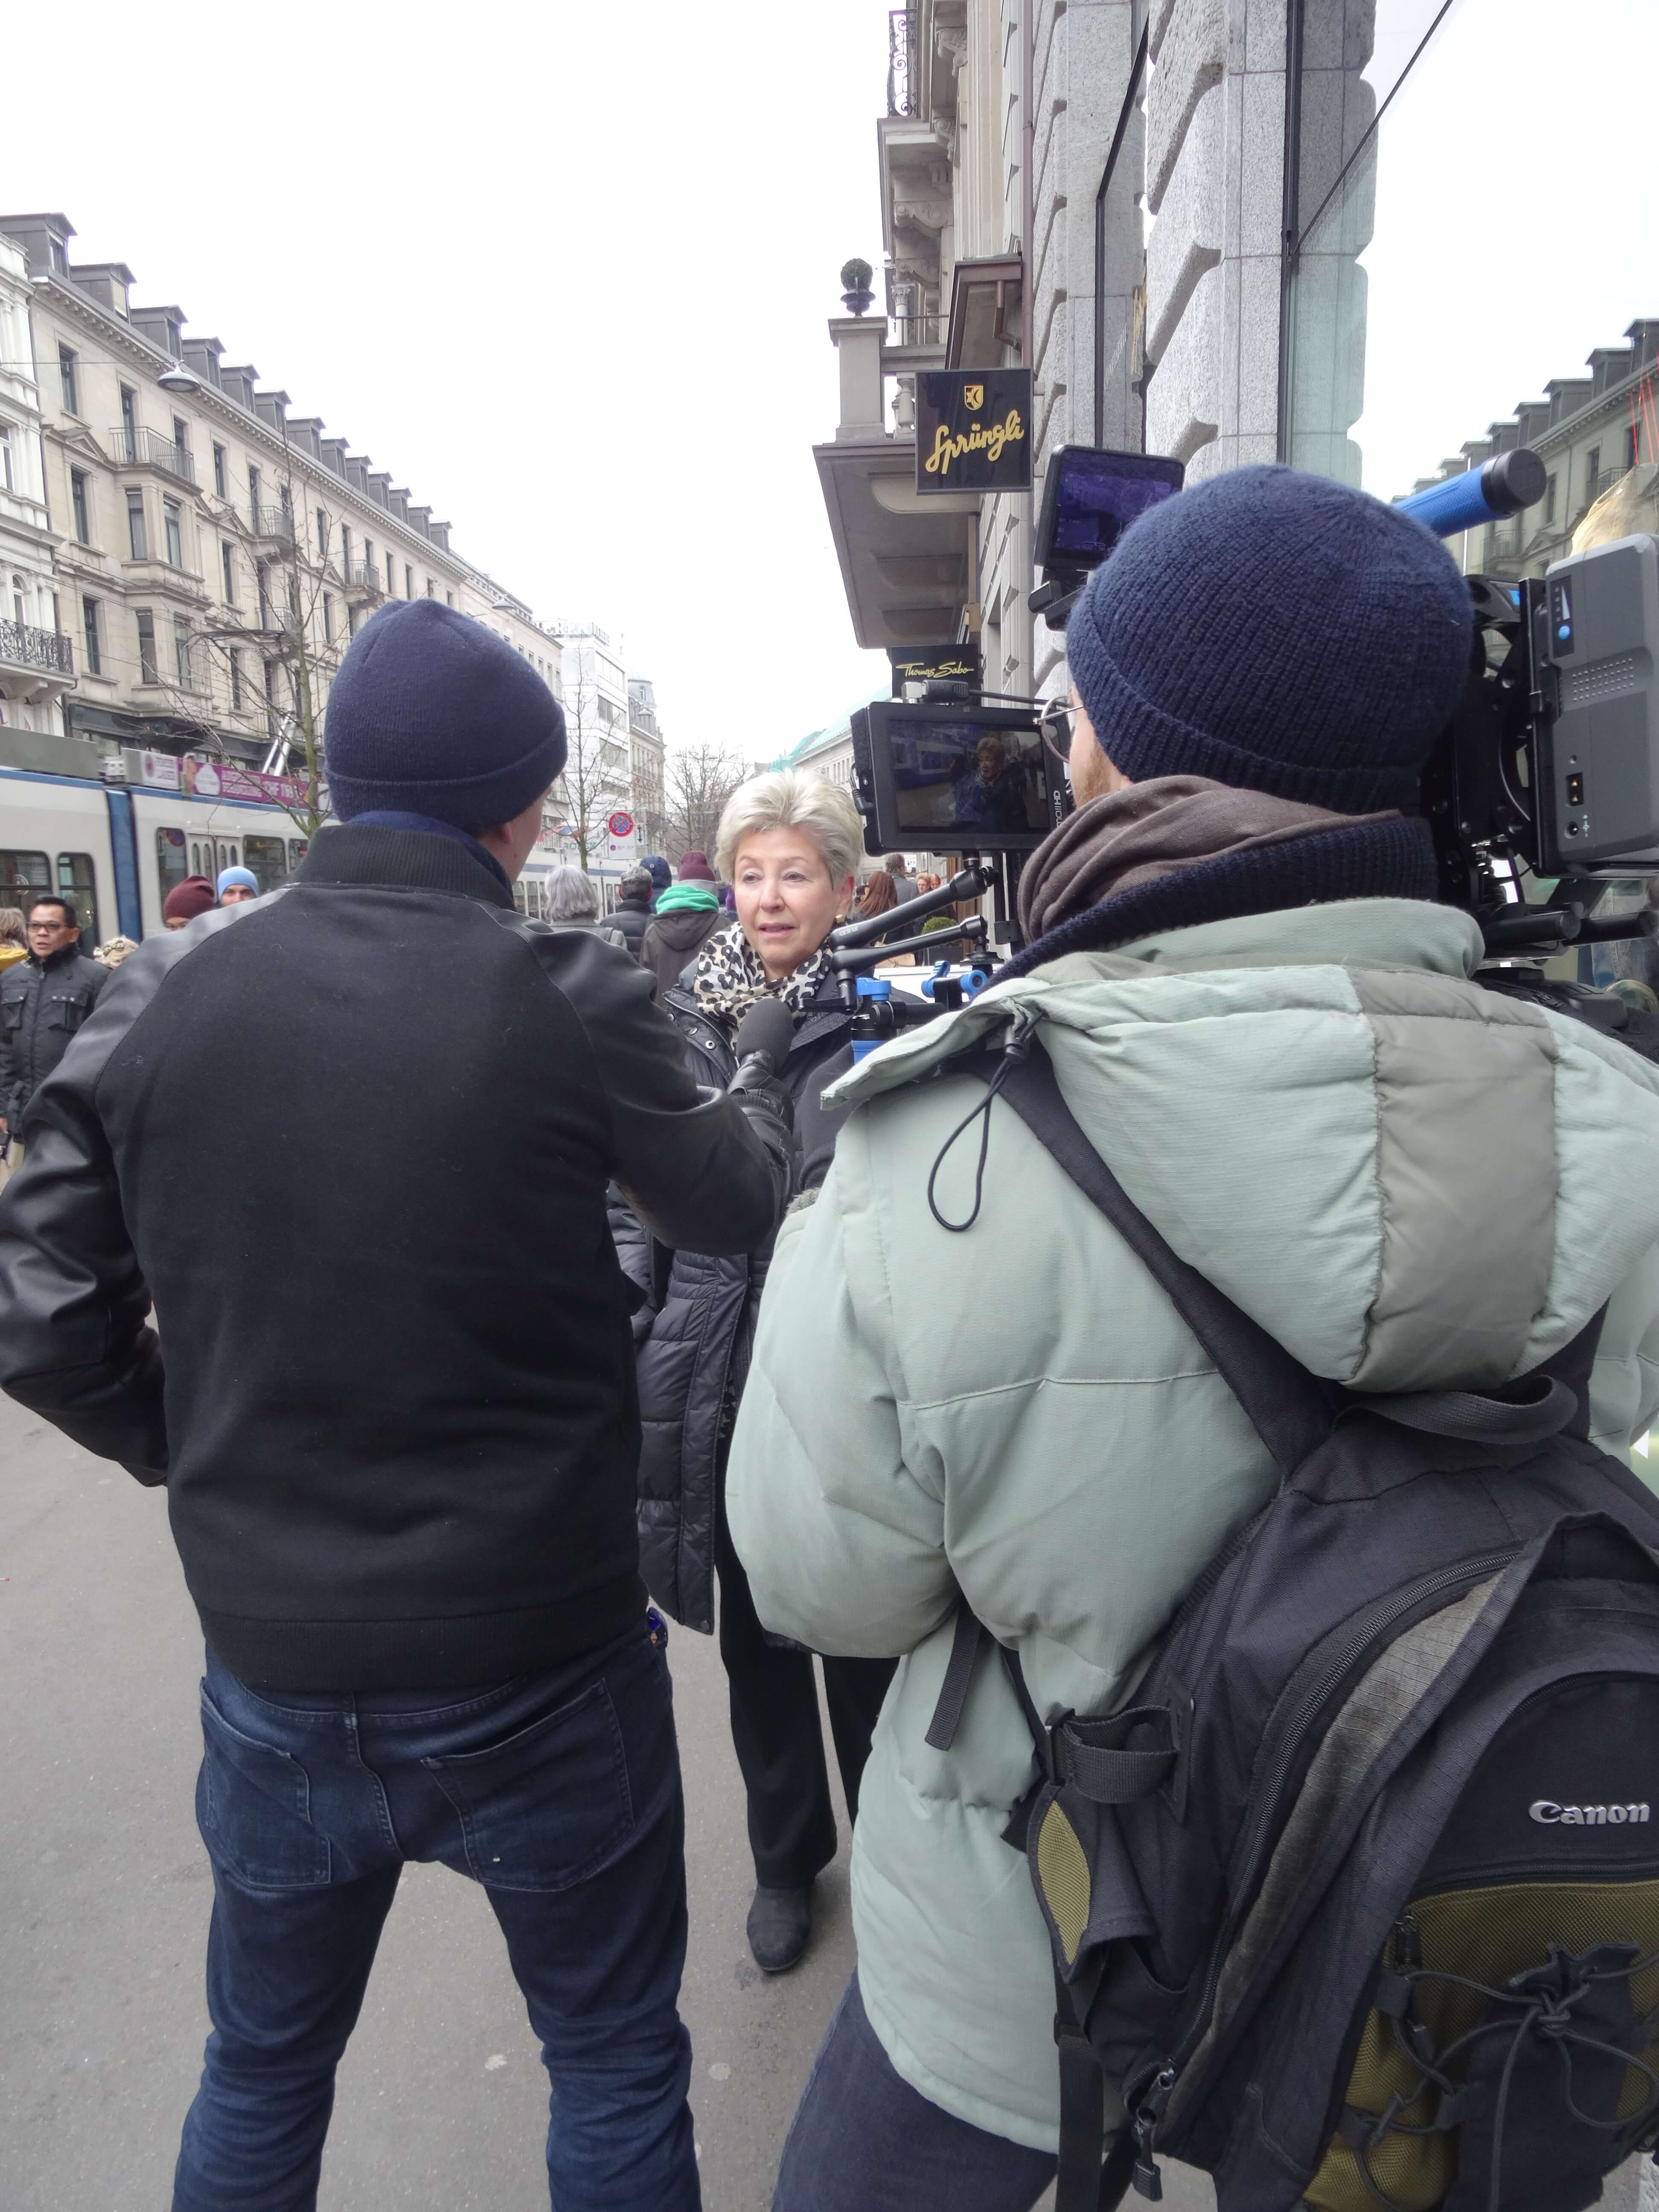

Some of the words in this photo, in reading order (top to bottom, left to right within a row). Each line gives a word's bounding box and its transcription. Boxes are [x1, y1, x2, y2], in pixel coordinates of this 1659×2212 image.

[925, 409, 1025, 475] Sprüngli
[896, 662, 936, 678] Thomas
[933, 661, 975, 678] Sabo
[1529, 1800, 1650, 1825] Canon
